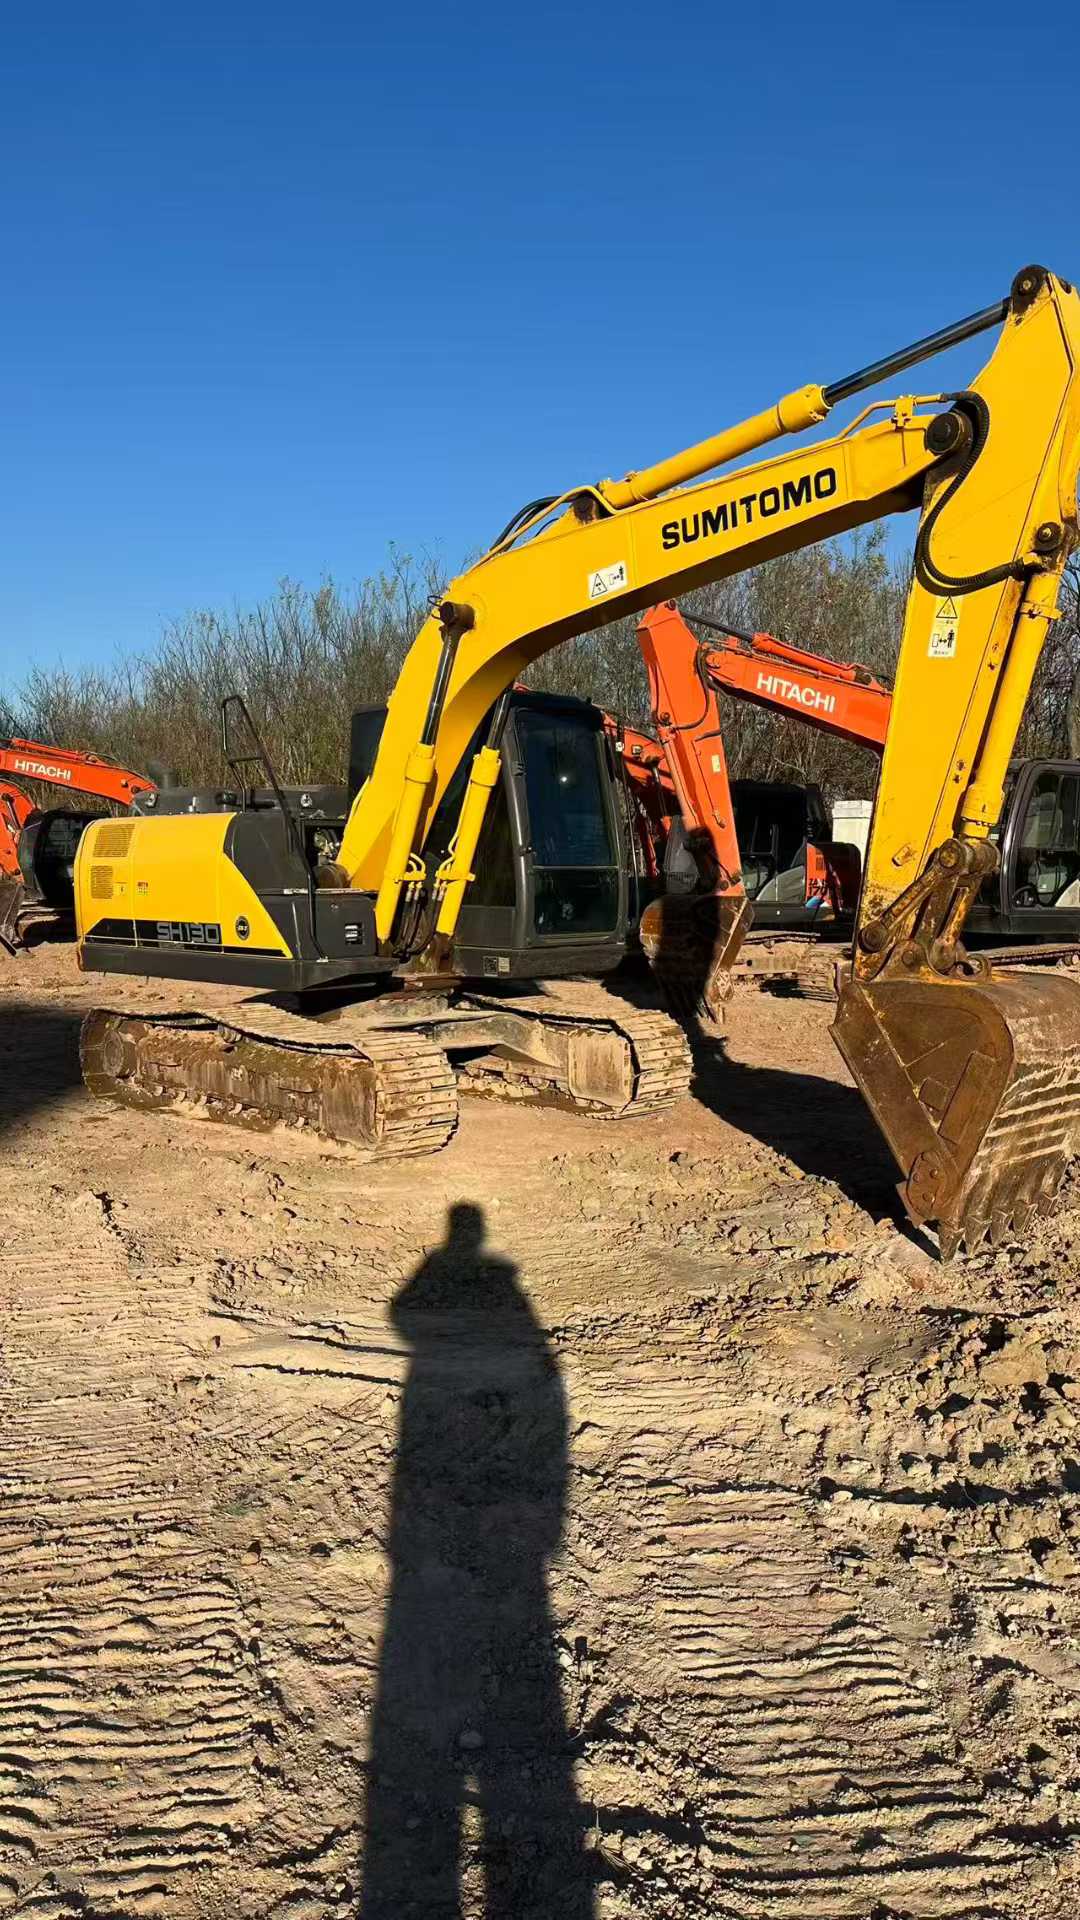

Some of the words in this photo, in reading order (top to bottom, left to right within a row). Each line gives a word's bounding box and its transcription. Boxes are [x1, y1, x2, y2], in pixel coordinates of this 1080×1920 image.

[661, 467, 836, 550] SUMITOMO
[756, 672, 836, 713] HITACHI
[15, 759, 71, 780] HITACHI
[156, 921, 220, 944] SH130
